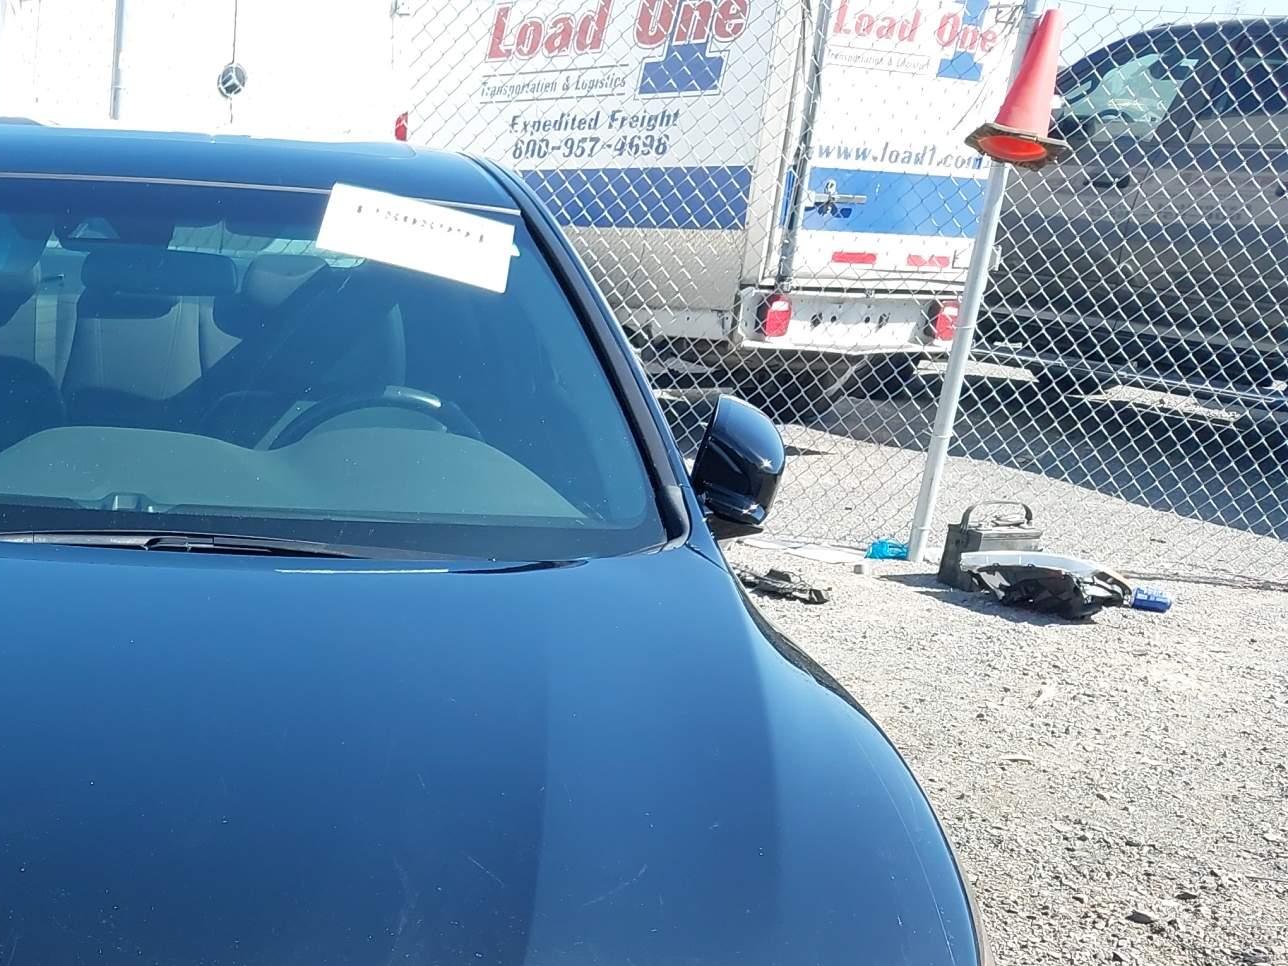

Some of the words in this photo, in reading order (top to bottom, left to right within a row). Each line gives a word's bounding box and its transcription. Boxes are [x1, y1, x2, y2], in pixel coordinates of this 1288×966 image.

[486, 0, 613, 60] Load
[634, 0, 750, 47] One
[833, 0, 920, 42] Load
[935, 12, 998, 51] One
[509, 110, 601, 136] Expedited
[608, 108, 681, 131] Freight
